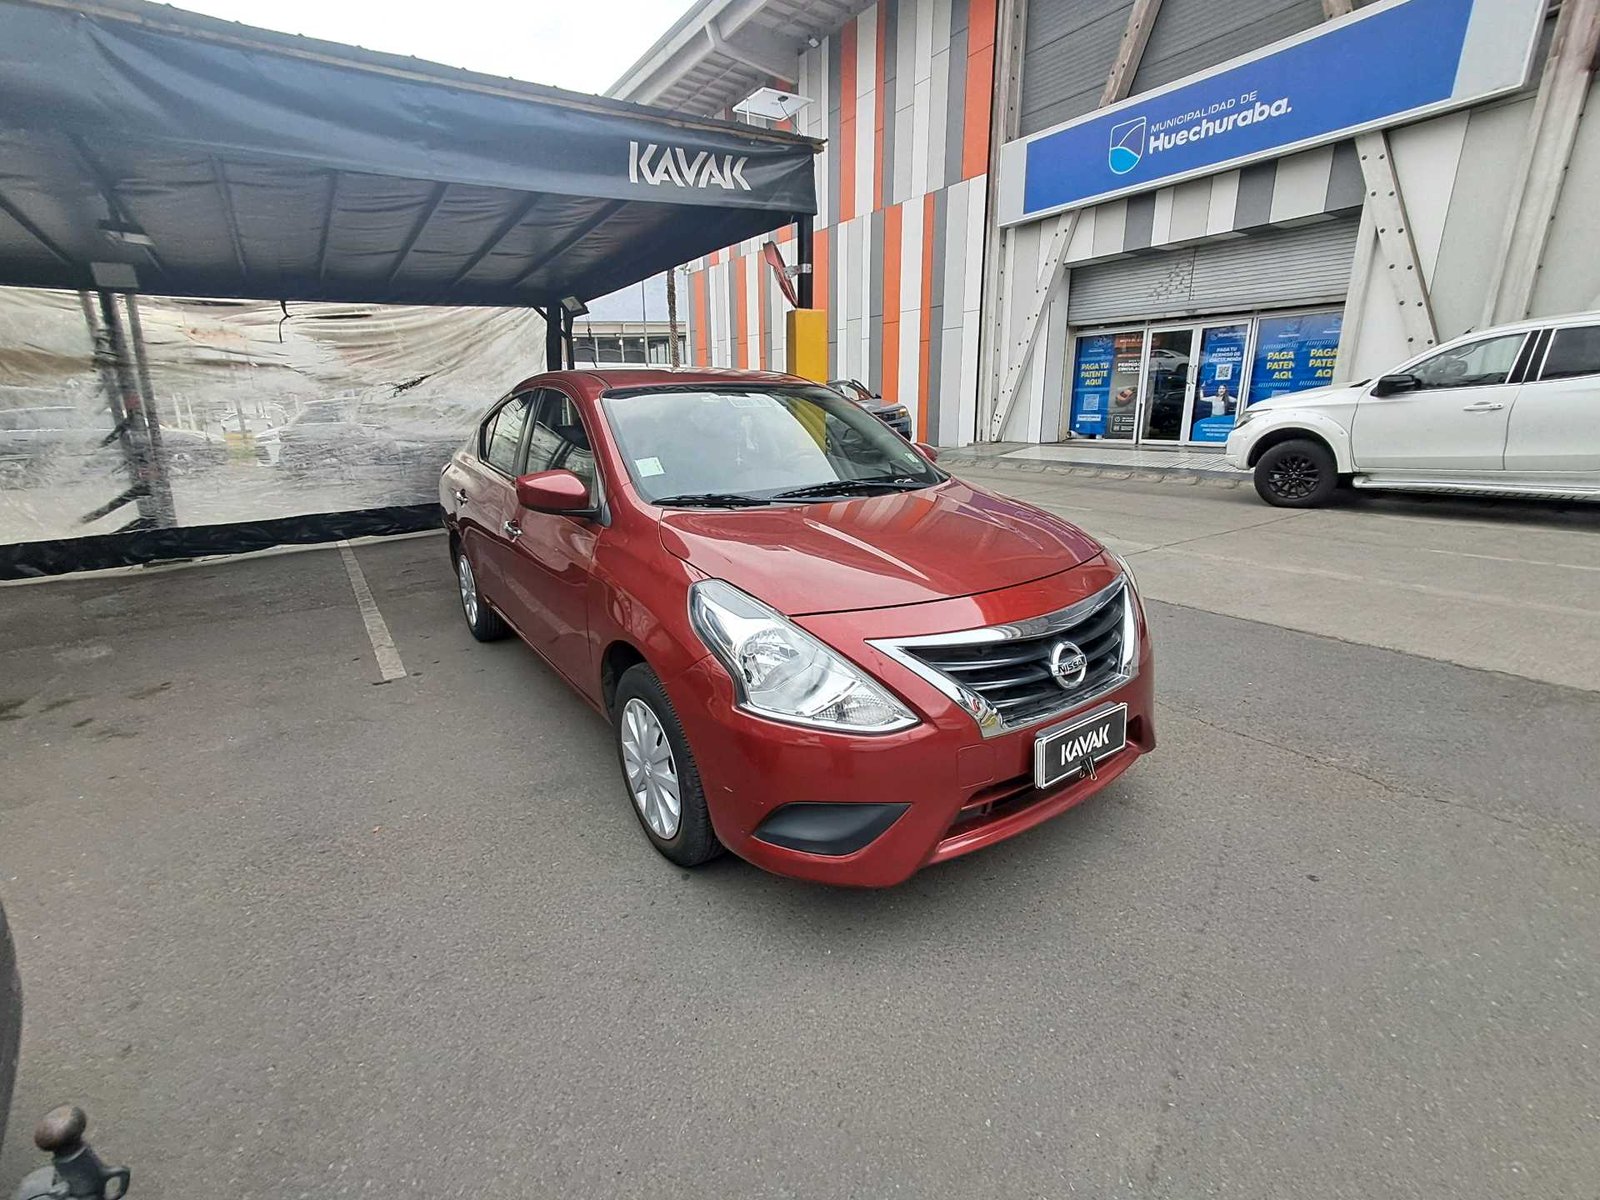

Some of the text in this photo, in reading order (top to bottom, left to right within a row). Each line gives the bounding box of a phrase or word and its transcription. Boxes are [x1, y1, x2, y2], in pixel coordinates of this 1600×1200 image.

[1150, 90, 1258, 133] MUNICIPALIDAD DE
[629, 140, 751, 191] KAVAK
[1267, 351, 1295, 360] PAGA
[1081, 370, 1108, 378] PATENTE
[1314, 369, 1333, 378] AQ
[1061, 723, 1110, 766] KAVAK
